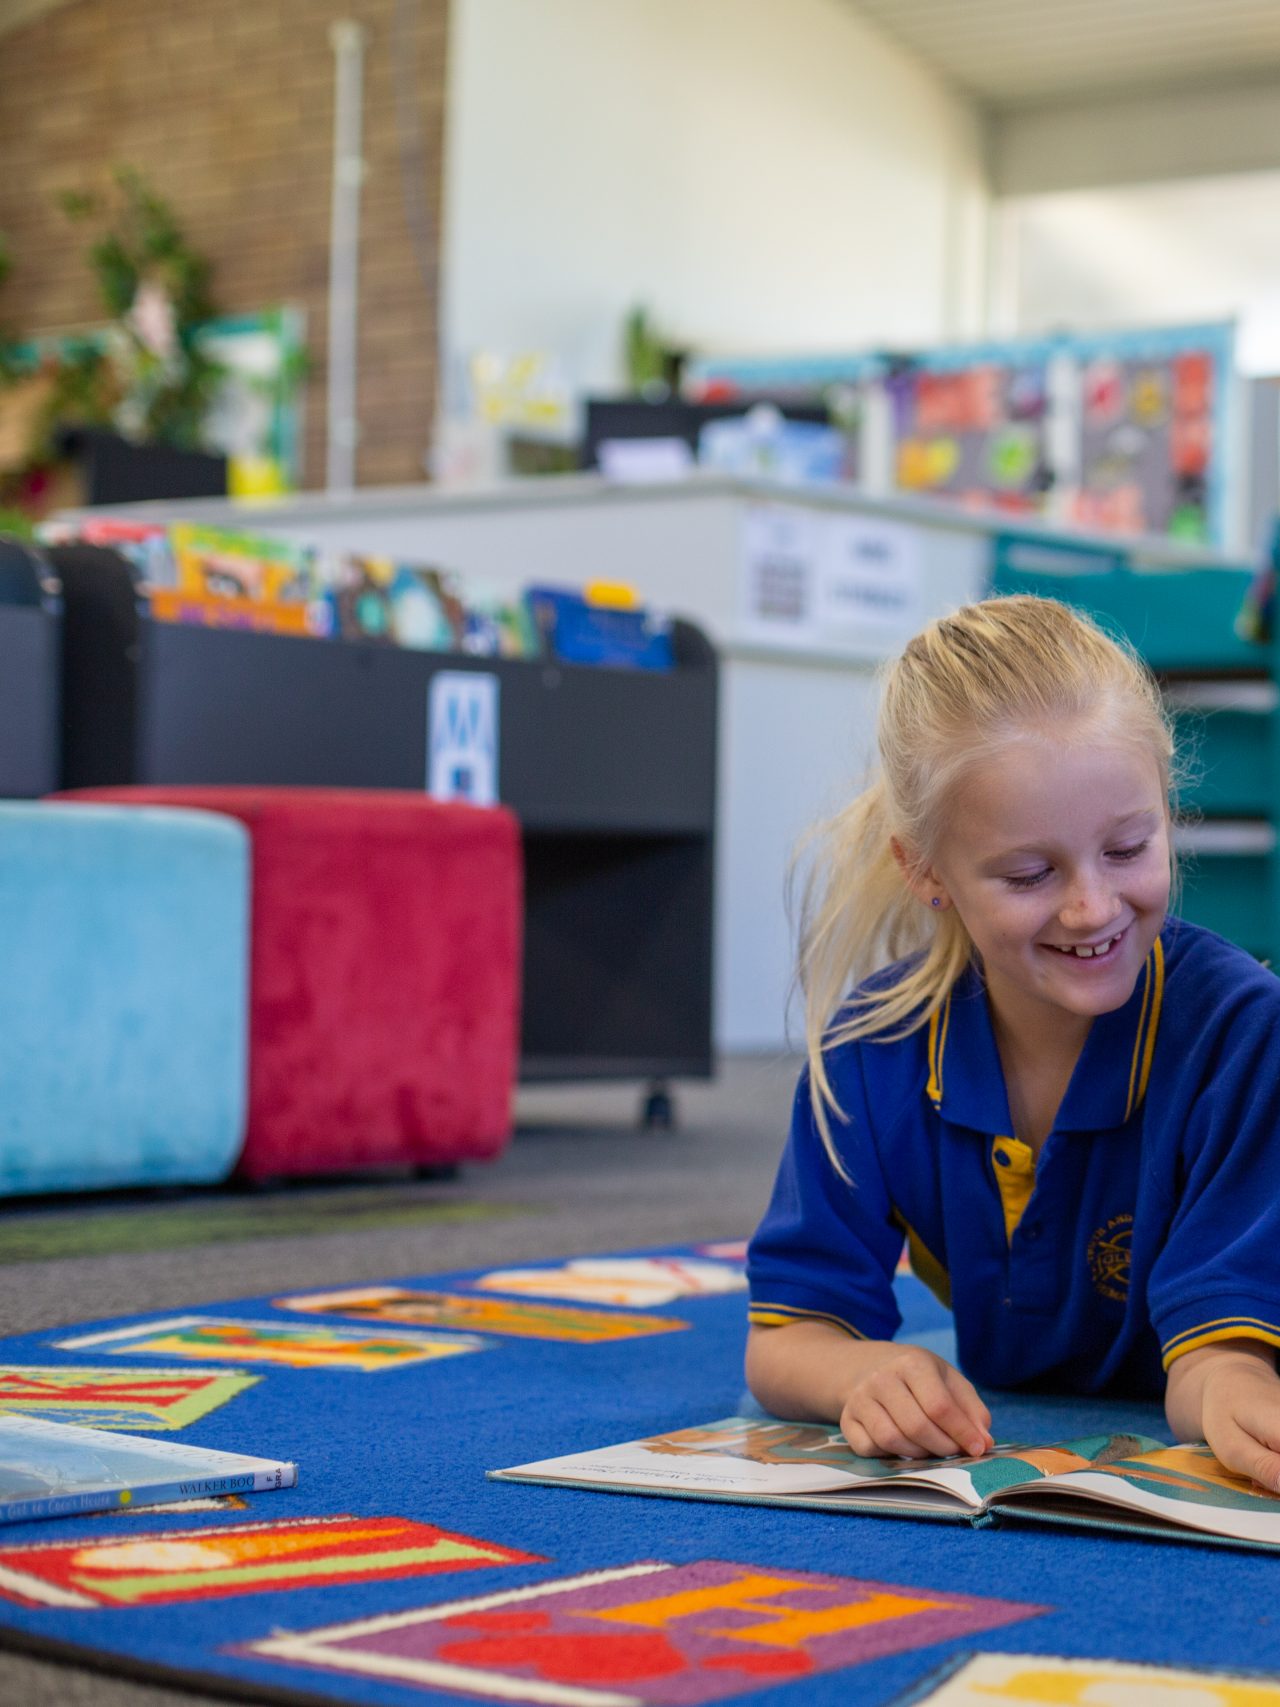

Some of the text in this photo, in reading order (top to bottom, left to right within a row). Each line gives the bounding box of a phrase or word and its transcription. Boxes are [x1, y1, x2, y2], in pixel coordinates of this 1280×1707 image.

[179, 1480, 227, 1495] WALKER
[274, 1467, 282, 1489] GRA
[568, 1570, 973, 1648] H
